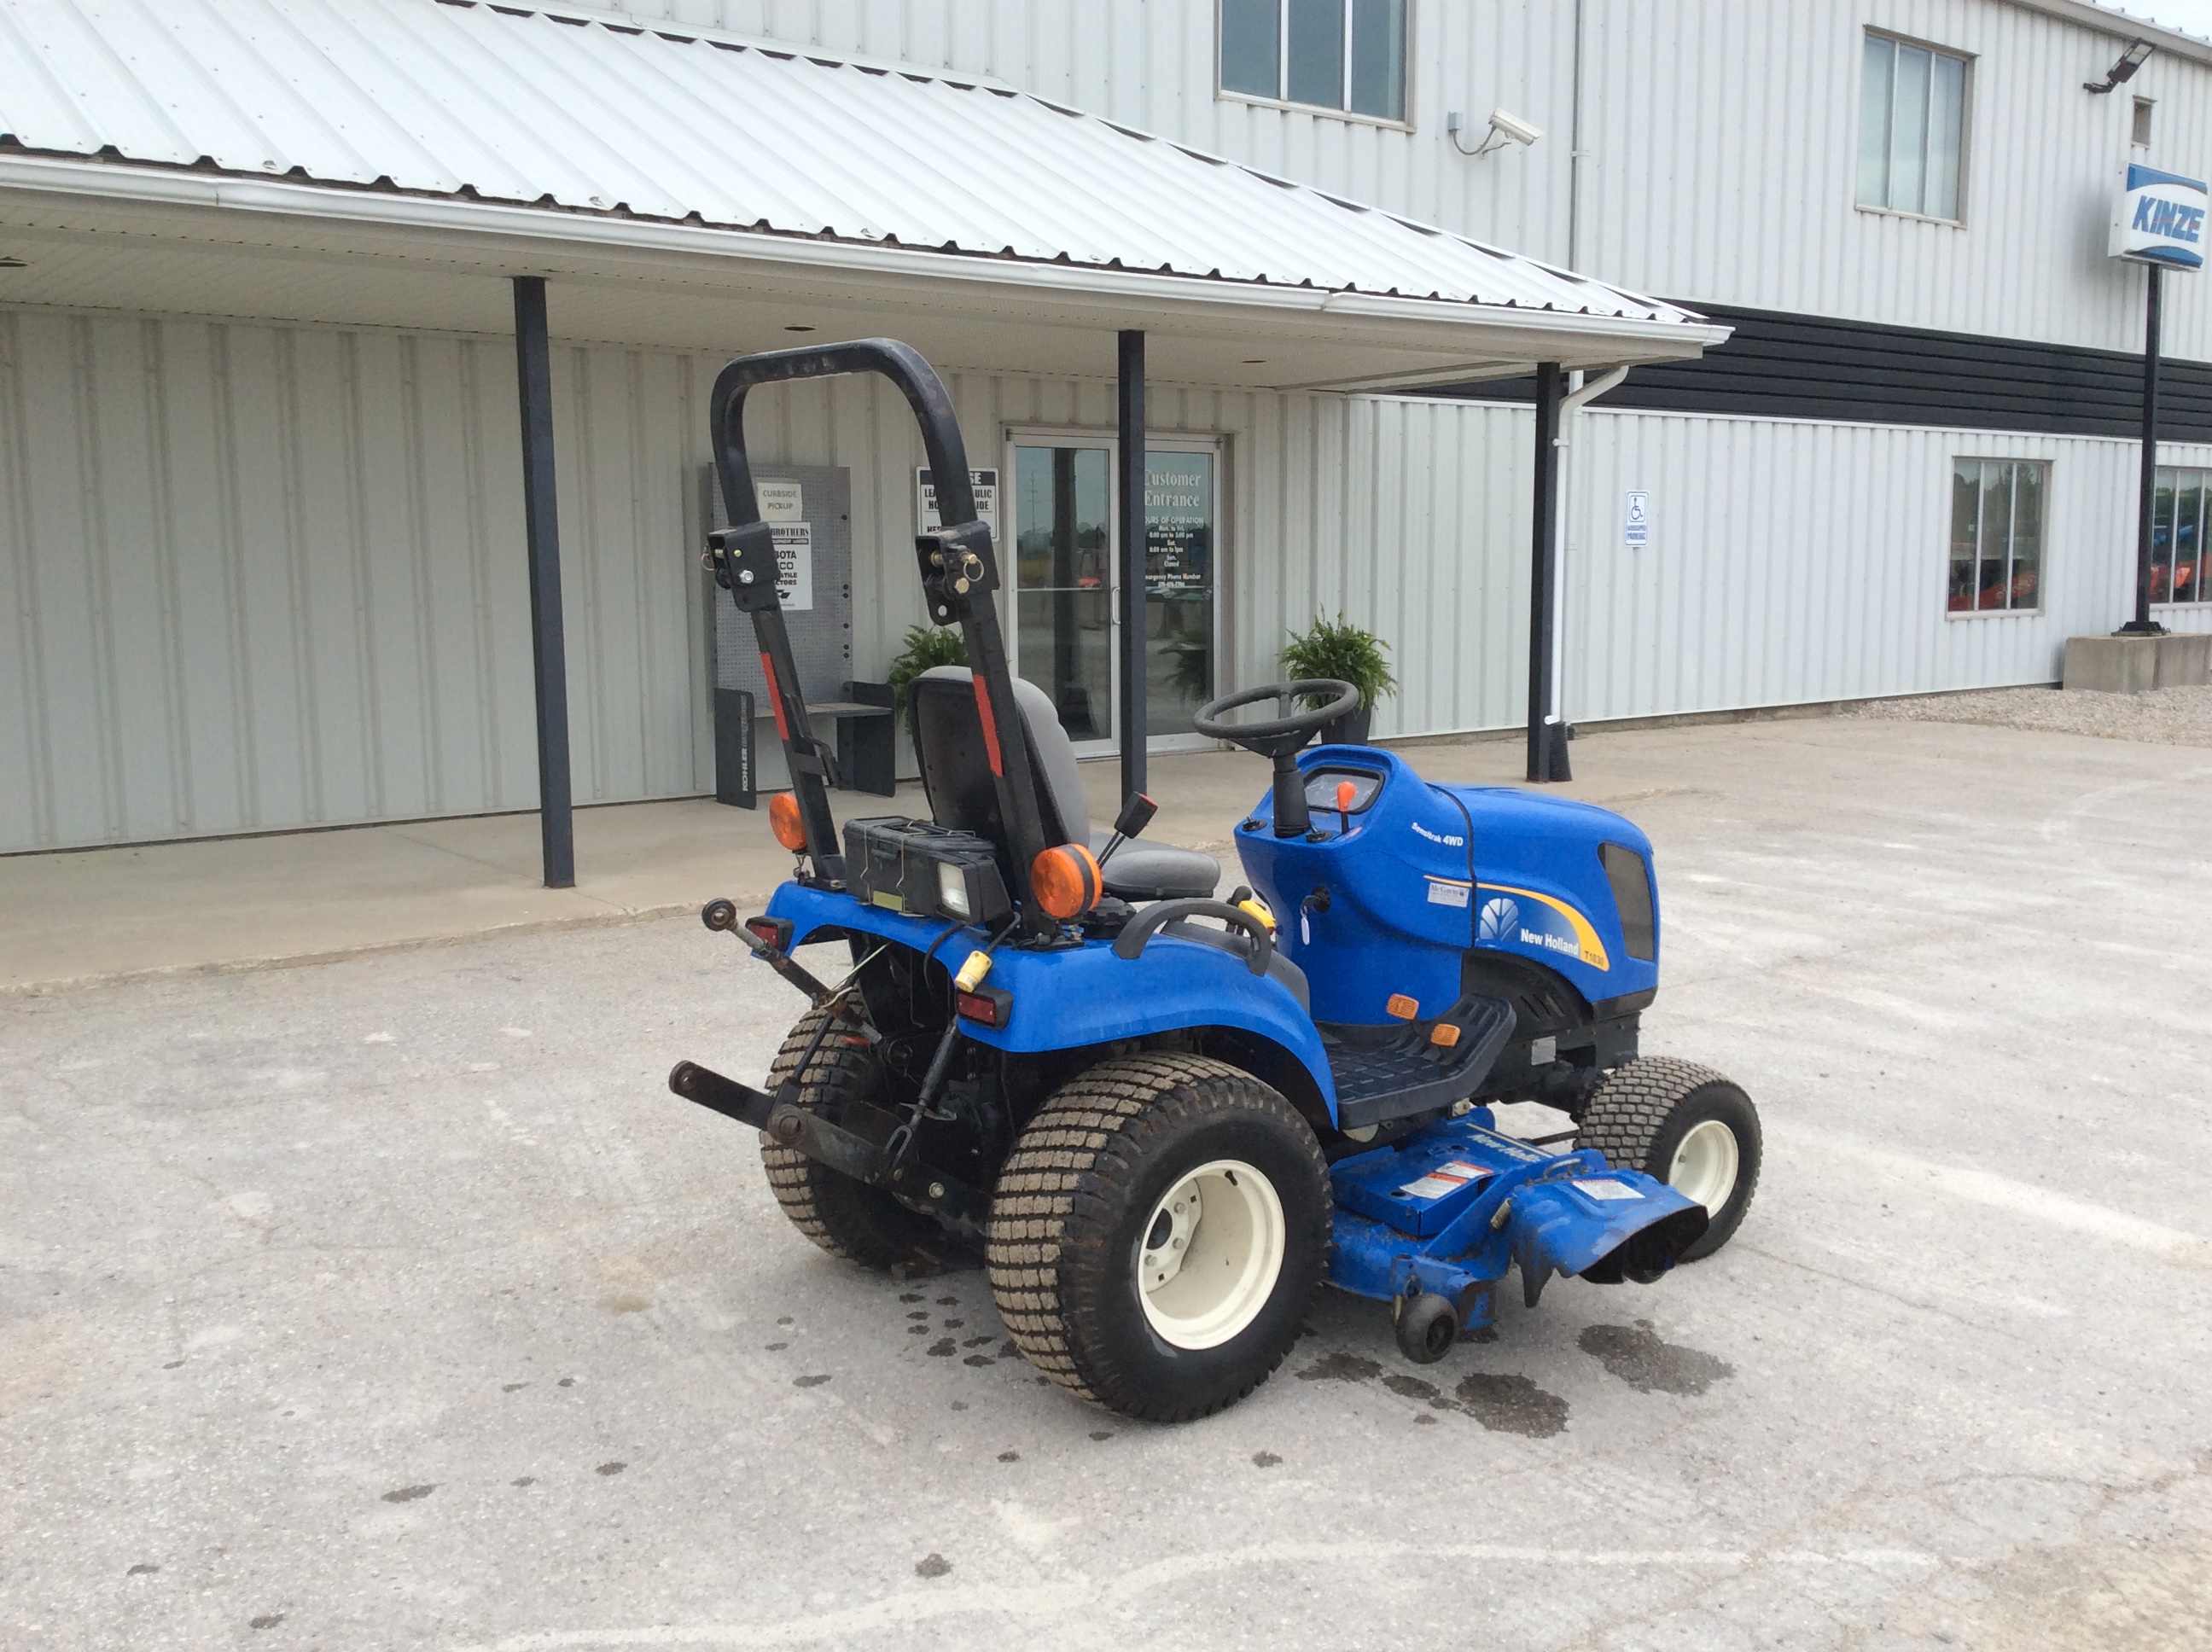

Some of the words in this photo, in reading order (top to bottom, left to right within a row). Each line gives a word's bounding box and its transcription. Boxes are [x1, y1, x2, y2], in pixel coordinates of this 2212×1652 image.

[2132, 195, 2205, 243] KINZE
[1144, 468, 1201, 486] Customer
[924, 488, 936, 497] LEA
[1144, 490, 1200, 506] Entrance
[771, 527, 809, 537] BROTHERS
[775, 550, 796, 560] BOTA
[779, 561, 794, 570] CO
[1443, 835, 1464, 846] 4WD
[1521, 928, 1543, 945] New
[1545, 934, 1579, 956] Holland
